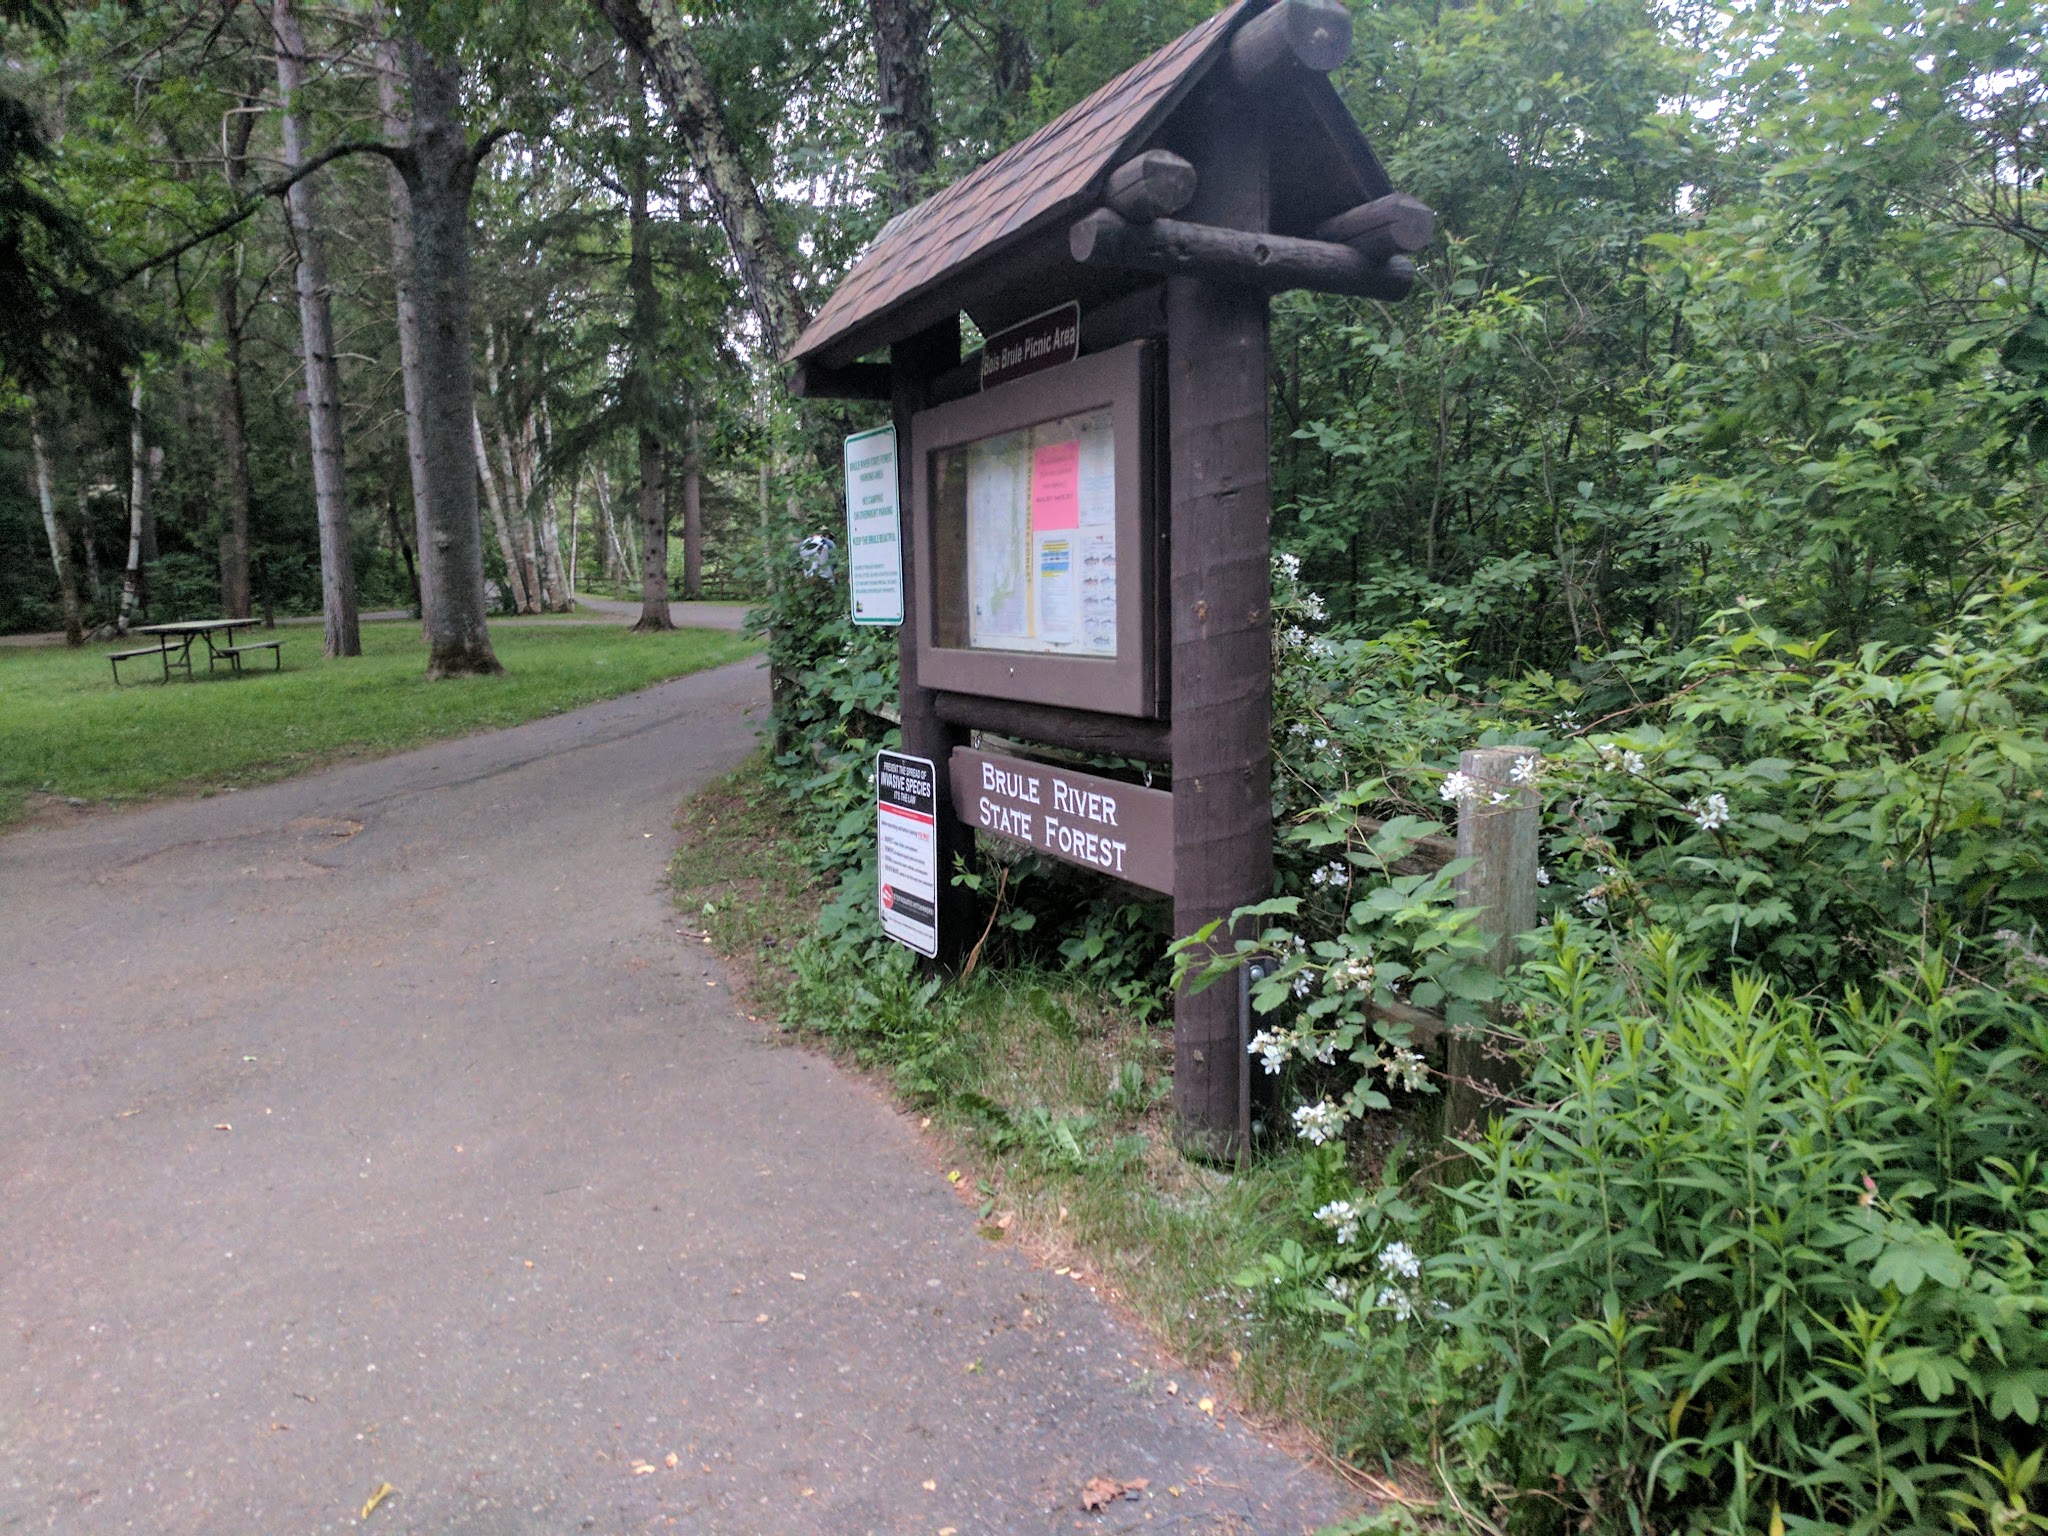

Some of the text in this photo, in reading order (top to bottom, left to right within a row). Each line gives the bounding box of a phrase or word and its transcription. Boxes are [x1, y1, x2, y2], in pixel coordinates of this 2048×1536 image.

[1002, 344, 1022, 369] Brule
[1024, 334, 1051, 360] Picnic
[1053, 326, 1076, 350] Area
[881, 771, 931, 797] INVASIVE SPECIES
[884, 762, 898, 773] PREVENT
[907, 767, 920, 779] SPREAD
[921, 770, 927, 780] OF
[908, 794, 916, 805] LAW
[982, 761, 1118, 826] BRULE RIVER
[980, 796, 1032, 843] STATE
[1044, 815, 1126, 872] FOREST
